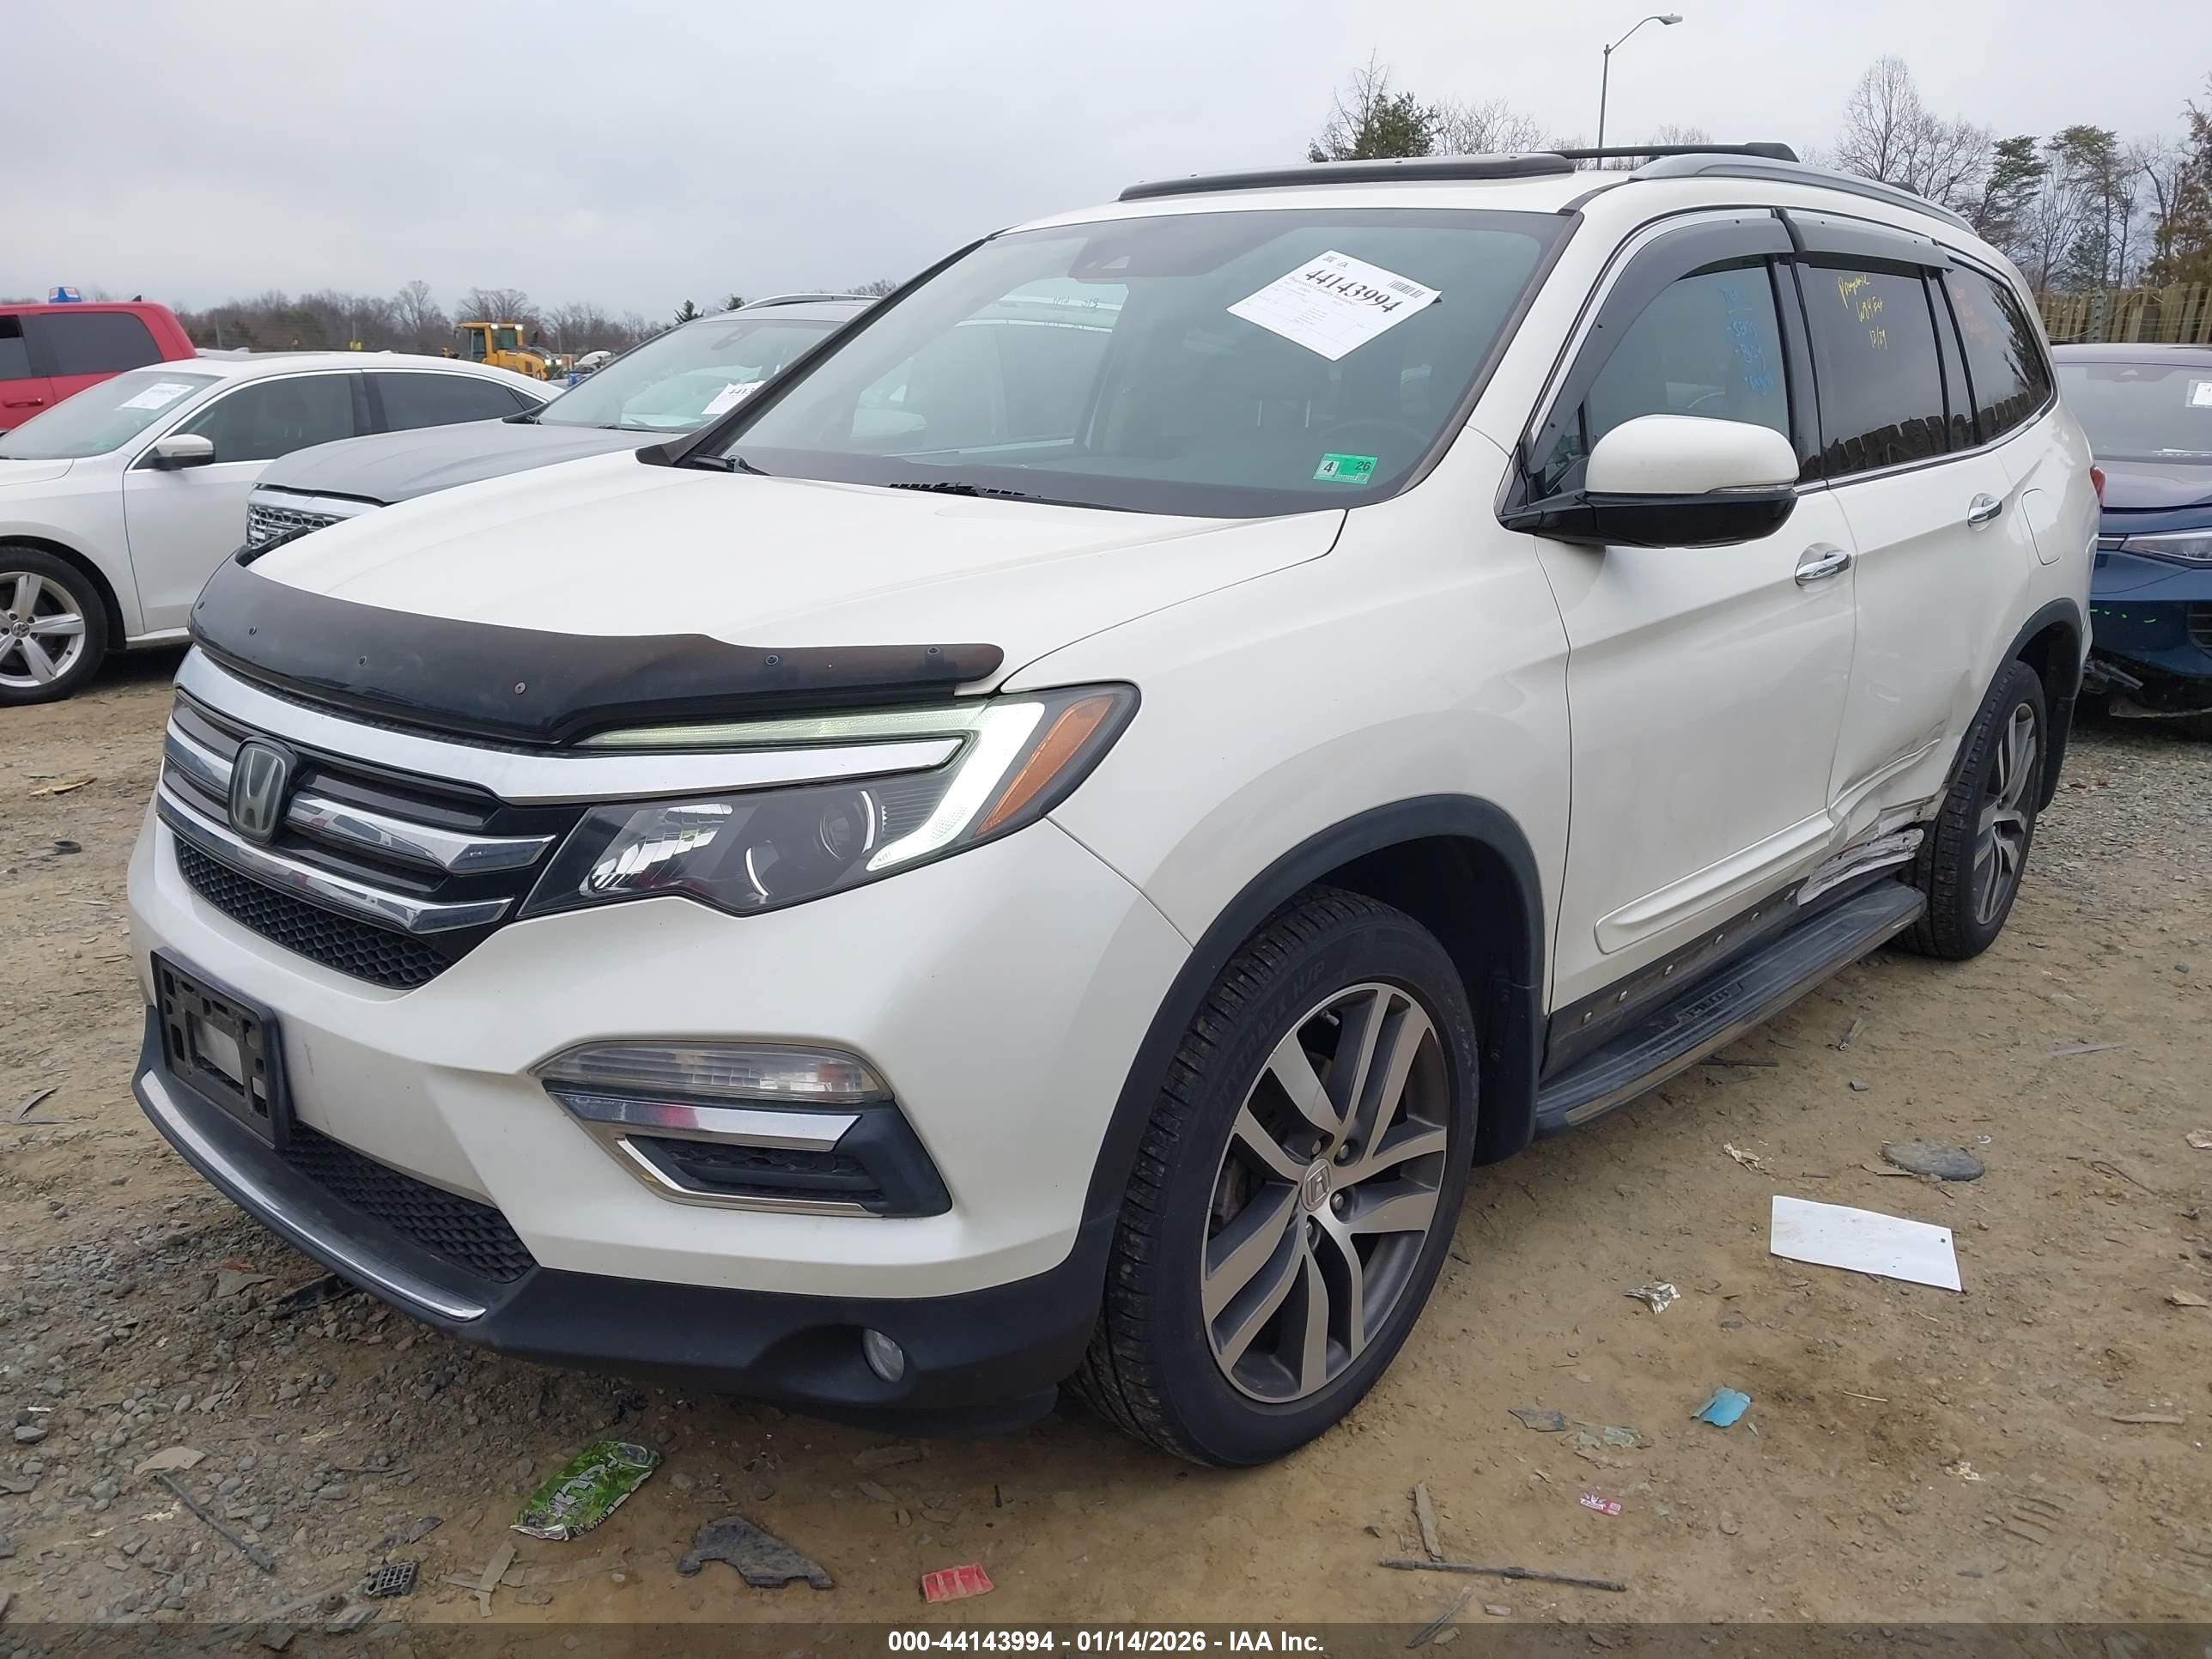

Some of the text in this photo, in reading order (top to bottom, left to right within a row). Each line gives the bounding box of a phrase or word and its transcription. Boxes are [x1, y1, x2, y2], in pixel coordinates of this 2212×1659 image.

[1304, 269, 1404, 313] 44143994
[1324, 460, 1371, 473] 4 26
